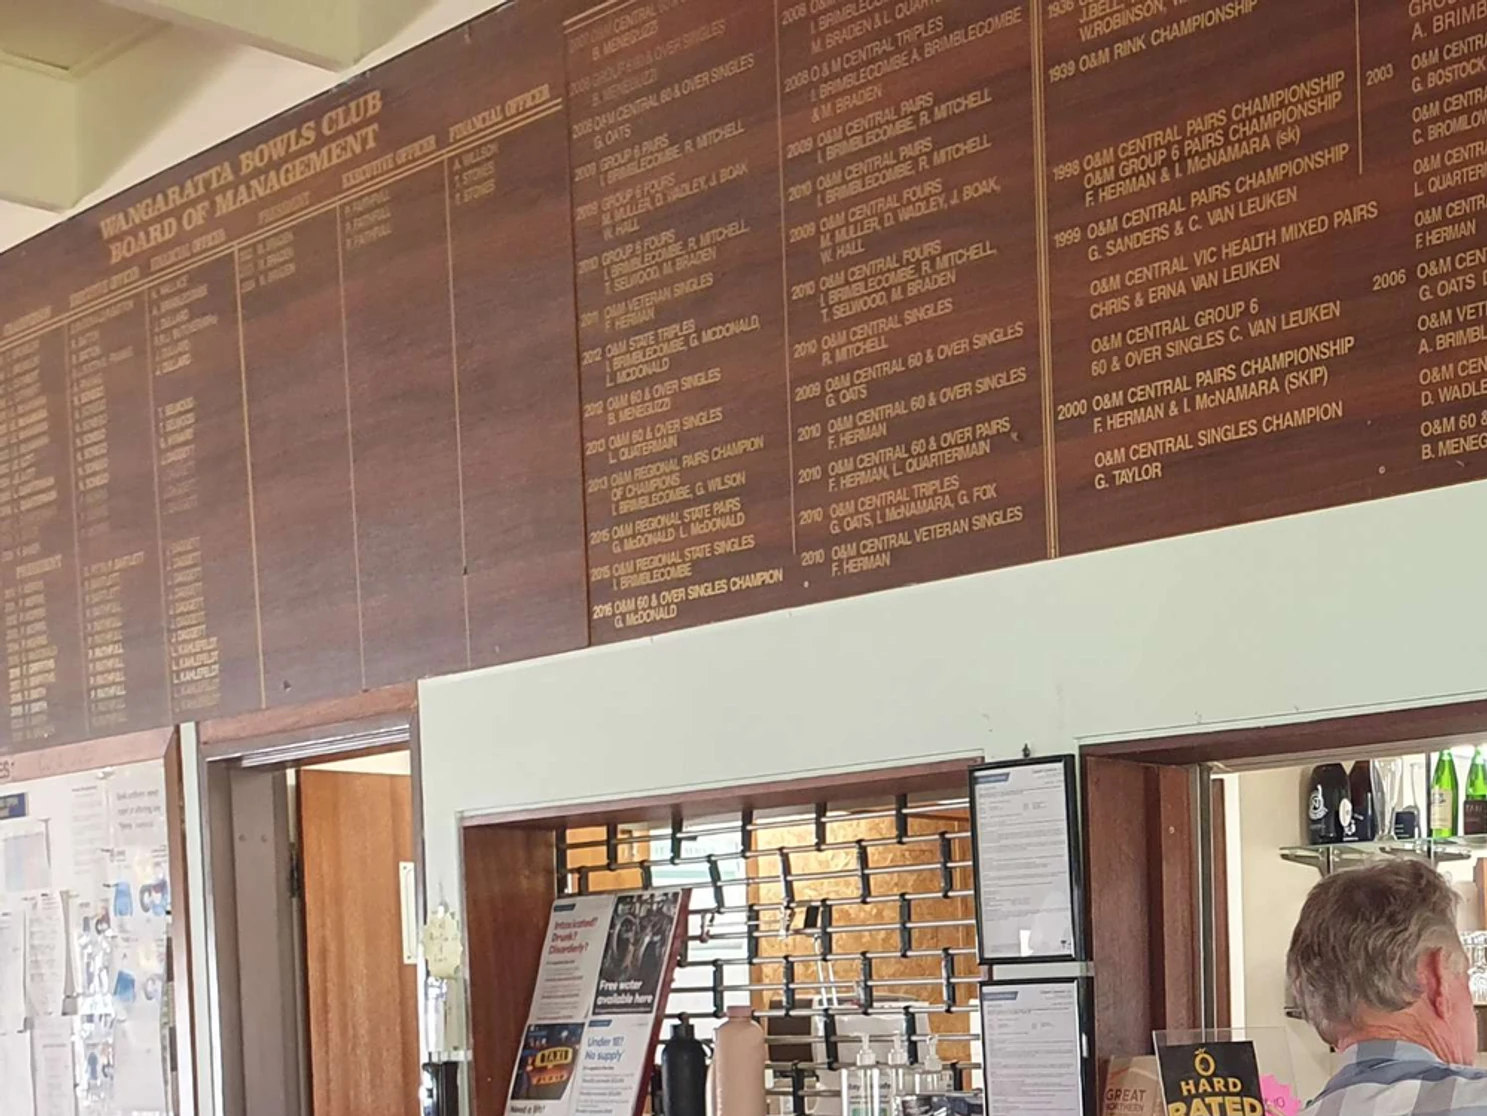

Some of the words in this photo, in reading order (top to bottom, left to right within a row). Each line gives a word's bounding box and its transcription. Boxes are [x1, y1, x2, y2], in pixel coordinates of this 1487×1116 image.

[100, 162, 234, 238] WANGARATTA
[239, 121, 315, 175] BOWLS
[322, 90, 381, 136] CLUB
[110, 218, 176, 264] BOARD
[182, 200, 209, 230] OF
[215, 124, 378, 217] MANAGEMENT
[1373, 269, 1406, 290] 2006
[1417, 256, 1451, 279] O&M
[1418, 310, 1452, 330] O&M
[1418, 338, 1432, 354] A.
[1058, 400, 1086, 420] 2000
[1092, 390, 1123, 410] O&M
[1128, 376, 1191, 403] CENTRAL
[1196, 364, 1236, 387] PAIRS
[1241, 336, 1354, 377] CHAMPIONSHIP
[1095, 448, 1125, 468] O&M
[1130, 434, 1193, 460] CENTRAL
[1198, 420, 1257, 446] SINGLES
[1262, 401, 1342, 432] CHAMPION
[1422, 444, 1434, 459] B.
[801, 549, 824, 566] 2010
[832, 542, 856, 560] O&M
[860, 532, 912, 554] CENTRAL
[914, 518, 968, 542] VETERAN
[972, 506, 1022, 530] SINGLES
[635, 993, 653, 1004] here
[1107, 1089, 1147, 1101] GREAT
[1181, 1078, 1242, 1095] HARD
